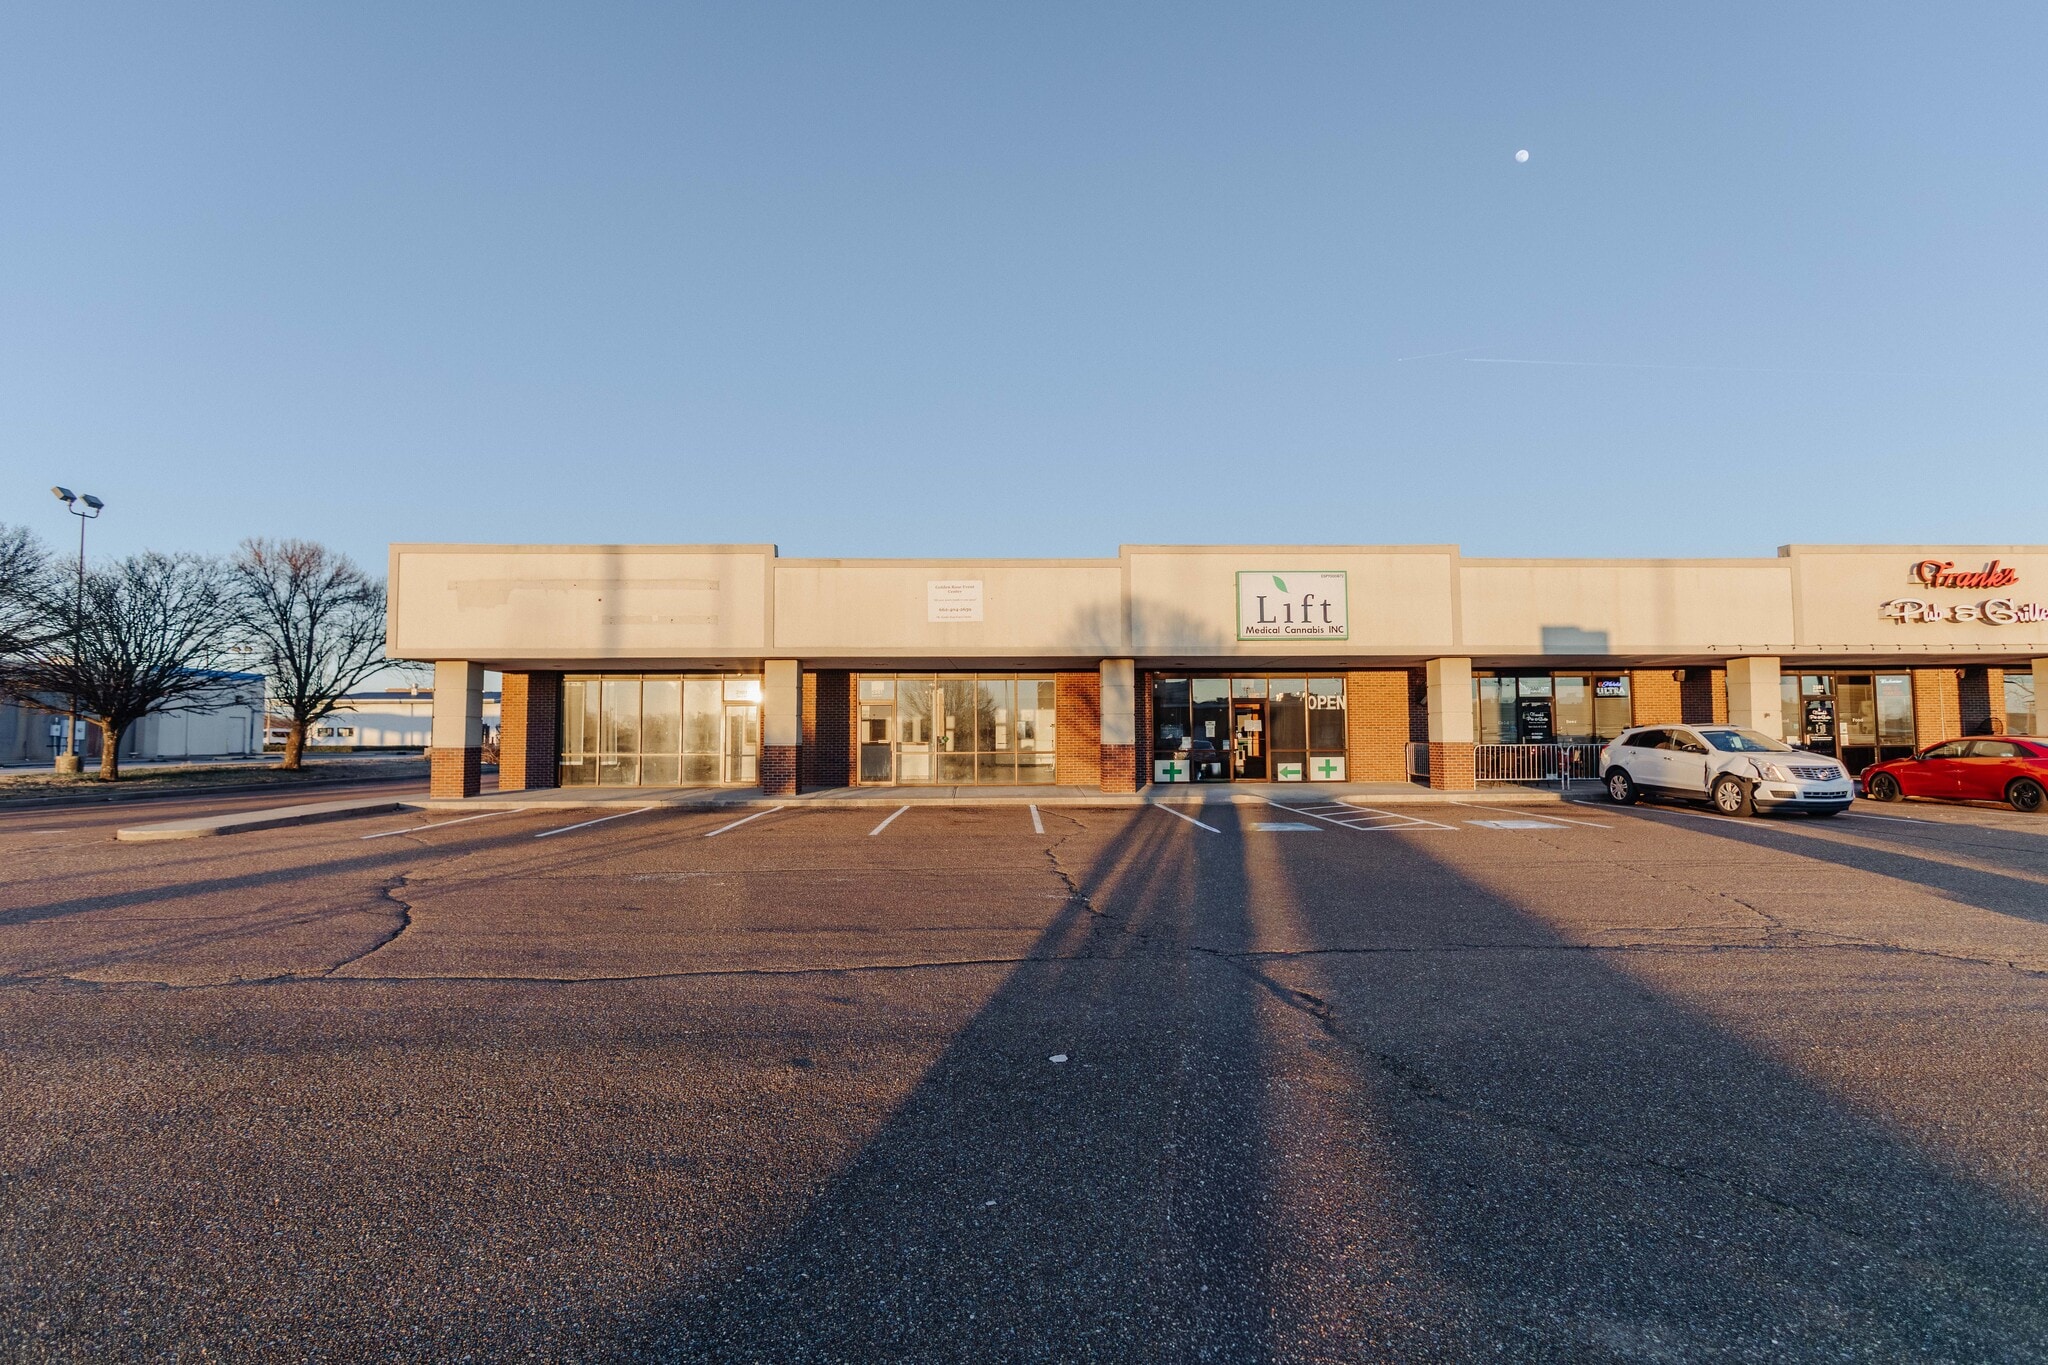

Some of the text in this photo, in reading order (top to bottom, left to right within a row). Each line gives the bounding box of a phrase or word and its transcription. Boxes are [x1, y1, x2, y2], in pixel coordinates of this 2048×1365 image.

[1917, 560, 2020, 588] Frank's
[1256, 594, 1333, 624] Lift
[1884, 598, 2048, 625] Pub & Grille
[1245, 626, 1280, 634] Medical
[1284, 626, 1325, 634] Cannabis
[1596, 687, 1626, 696] ULTRA
[1308, 695, 1346, 710] OPEN
